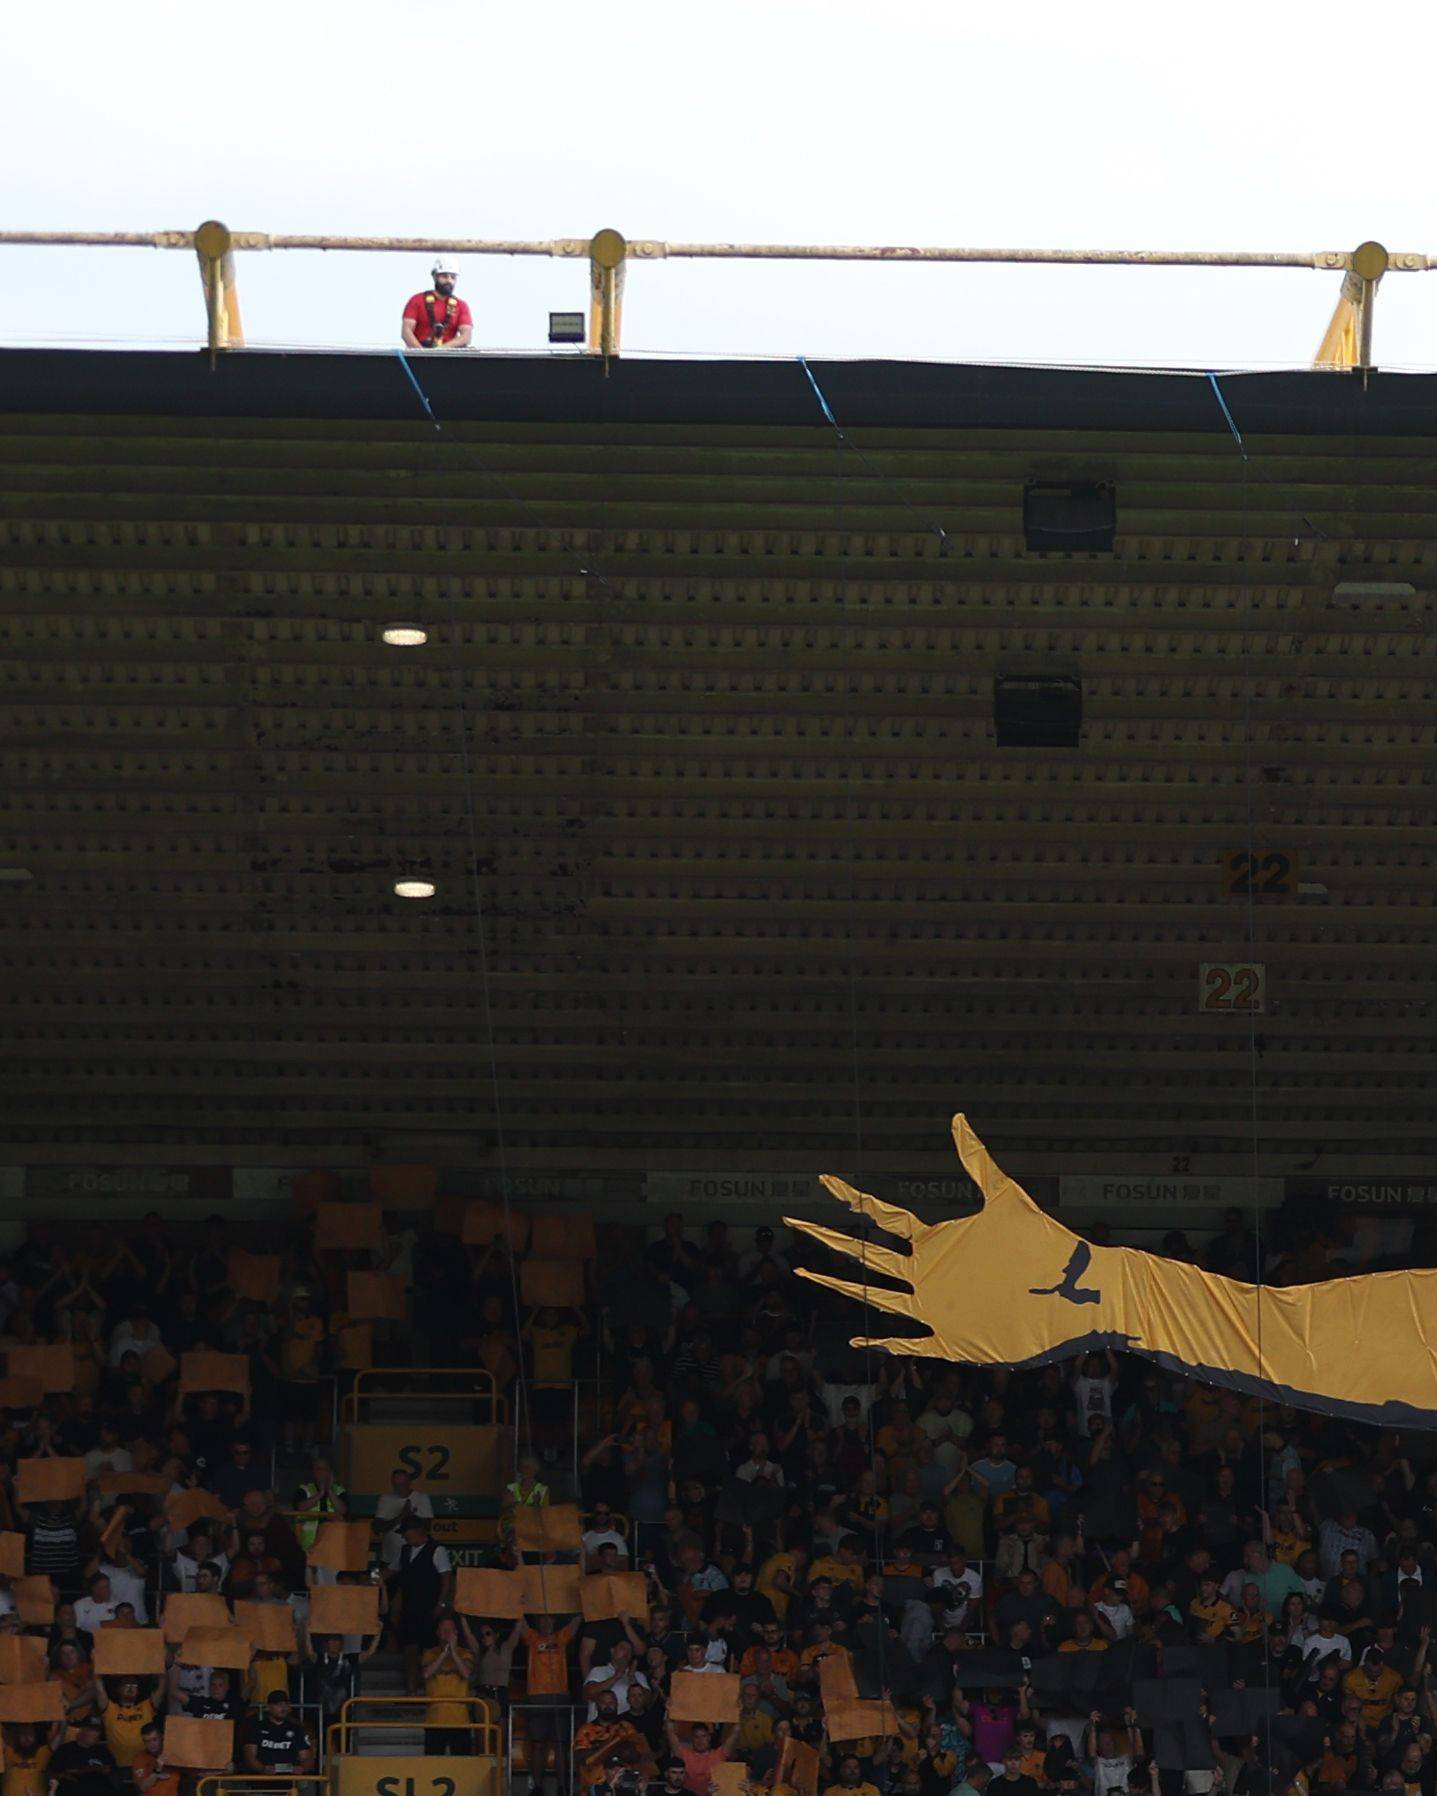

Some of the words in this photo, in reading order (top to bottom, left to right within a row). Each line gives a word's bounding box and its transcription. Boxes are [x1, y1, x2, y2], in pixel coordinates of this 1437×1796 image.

[1231, 853, 1291, 893] 22
[1206, 968, 1260, 1009] 22
[690, 1181, 766, 1196] FOSUN
[1104, 1184, 1177, 1201] FOSUN
[1327, 1186, 1403, 1203] FOSUN
[399, 1445, 450, 1481] S2
[449, 1549, 485, 1567] XIT
[261, 1739, 292, 1751] DEBET
